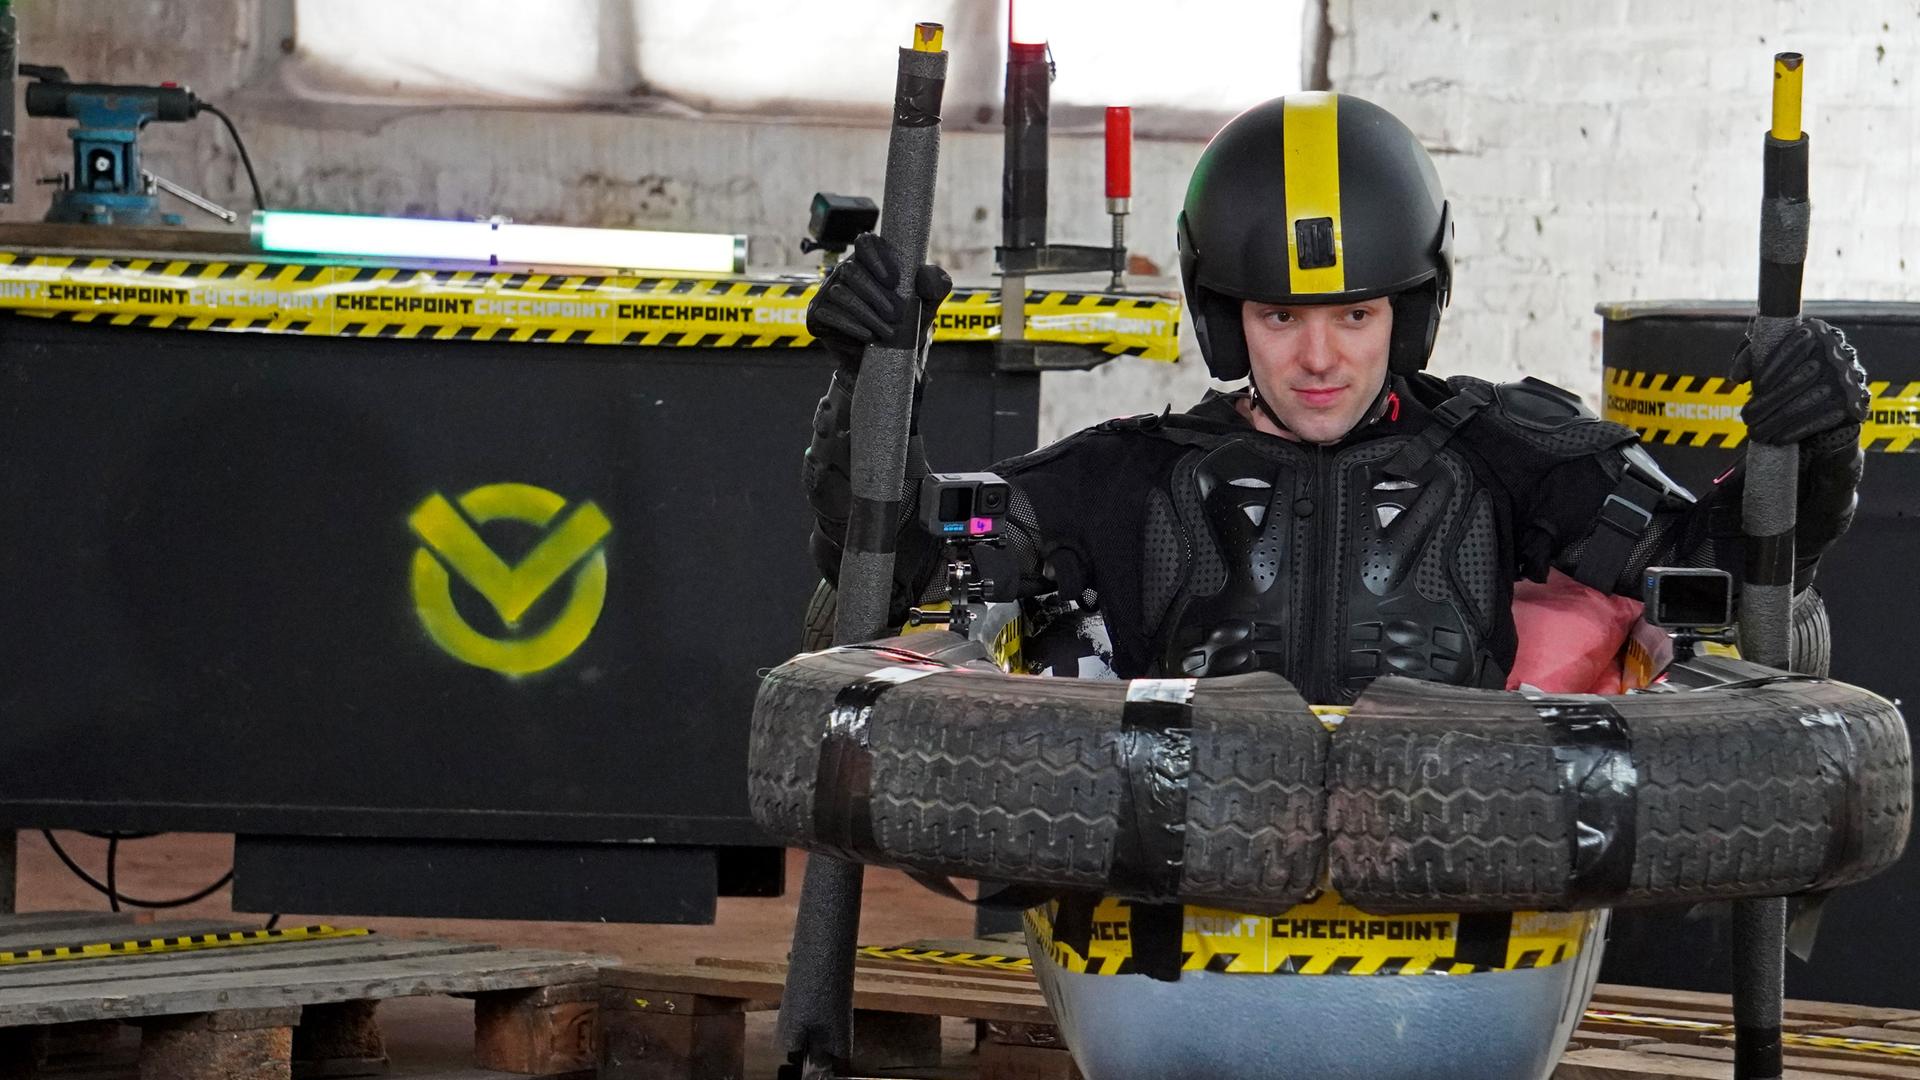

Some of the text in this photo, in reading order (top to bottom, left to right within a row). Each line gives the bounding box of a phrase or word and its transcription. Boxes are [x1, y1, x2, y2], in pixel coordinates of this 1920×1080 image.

[49, 284, 189, 304] CHECKPOINT
[190, 287, 330, 310] CHECKPOINT
[337, 294, 473, 314] CHECKPOINT
[474, 299, 610, 319] CHECKPOINT
[618, 304, 754, 323] CHECKPOINT
[1608, 395, 1665, 416] CHECKPOINT
[1271, 919, 1451, 941] CHECKPOINT
